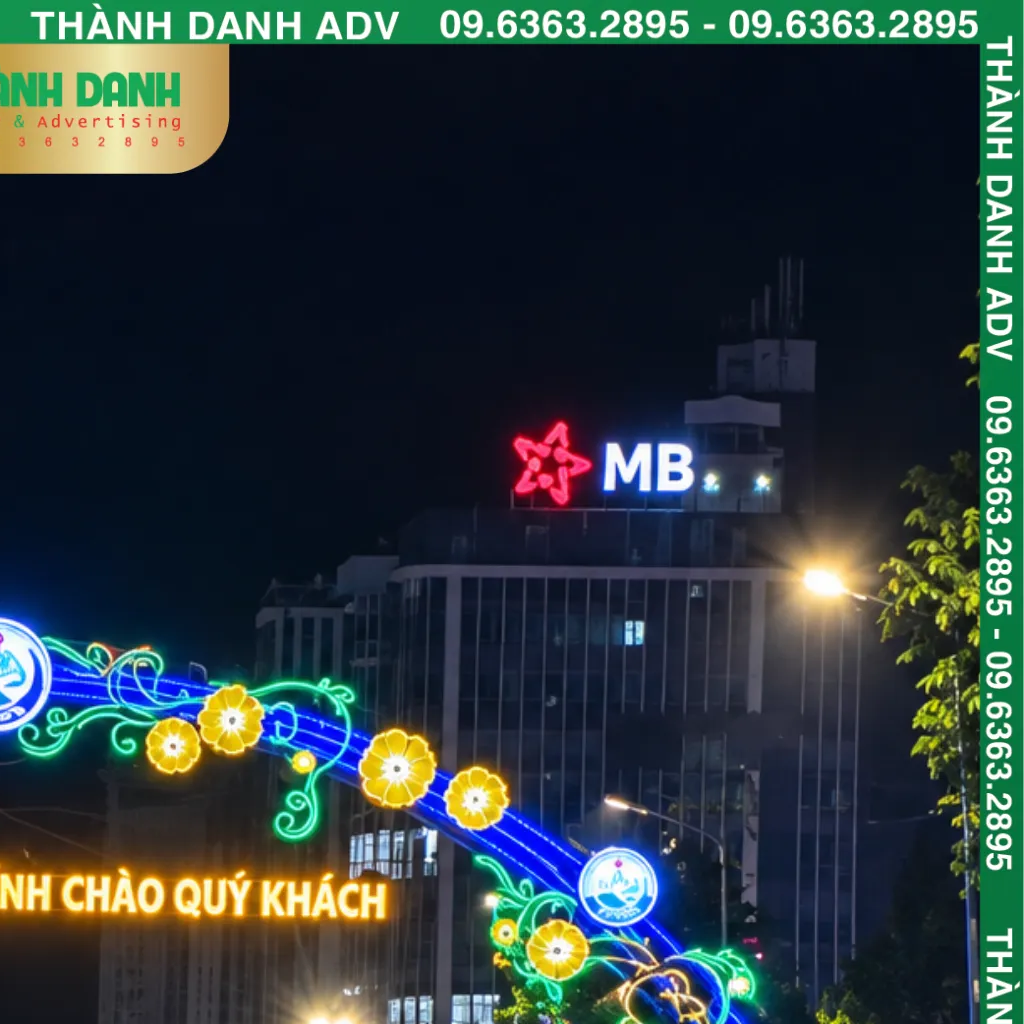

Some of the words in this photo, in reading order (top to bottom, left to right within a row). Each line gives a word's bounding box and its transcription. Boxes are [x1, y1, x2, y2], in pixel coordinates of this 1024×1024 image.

[603, 442, 695, 491] MB
[61, 867, 164, 914] CHÀO
[174, 870, 247, 918] QUÝ
[260, 873, 387, 919] KHÁCH
